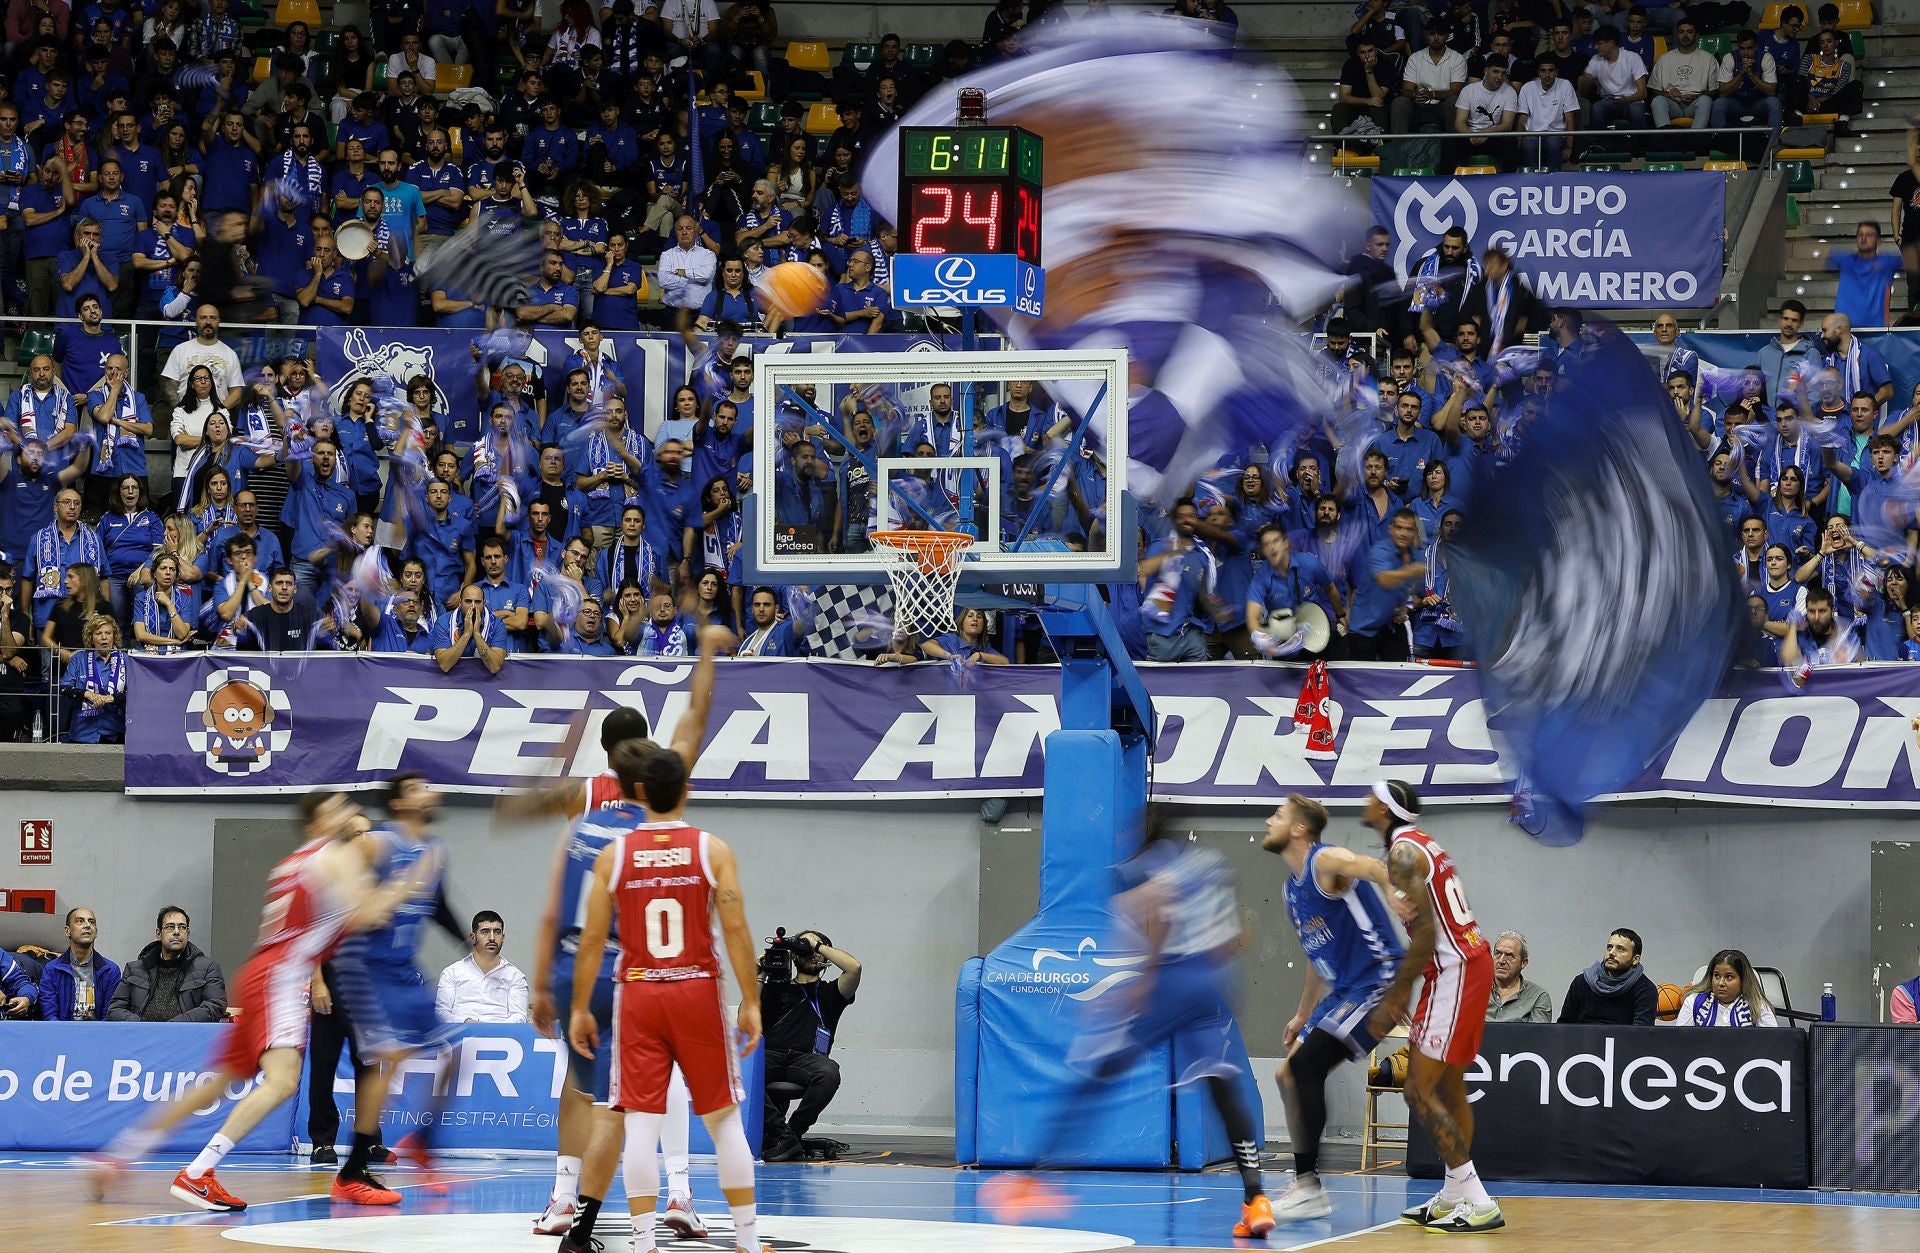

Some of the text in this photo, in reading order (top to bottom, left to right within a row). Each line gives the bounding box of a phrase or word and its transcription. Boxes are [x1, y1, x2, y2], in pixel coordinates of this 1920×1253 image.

[930, 136, 1008, 171] 6:11
[1488, 185, 1627, 217] GRUPO
[914, 187, 999, 254] 24
[1017, 186, 1038, 258] 24
[1488, 219, 1632, 259] GARCÍA
[903, 289, 1007, 304] LEXUS
[1518, 270, 1698, 302] AMARERO
[1015, 295, 1041, 316] LEXUS
[775, 541, 814, 551] endesa
[776, 532, 794, 543] liga
[357, 664, 811, 781] PEÑA
[632, 847, 693, 868] SPISSU
[644, 898, 685, 960] 0
[1010, 985, 1061, 995] FUNDACIÓN
[31, 1054, 94, 1102] de
[1463, 1036, 1792, 1114] endesa
[440, 1105, 559, 1128] ESTRATÉGI
